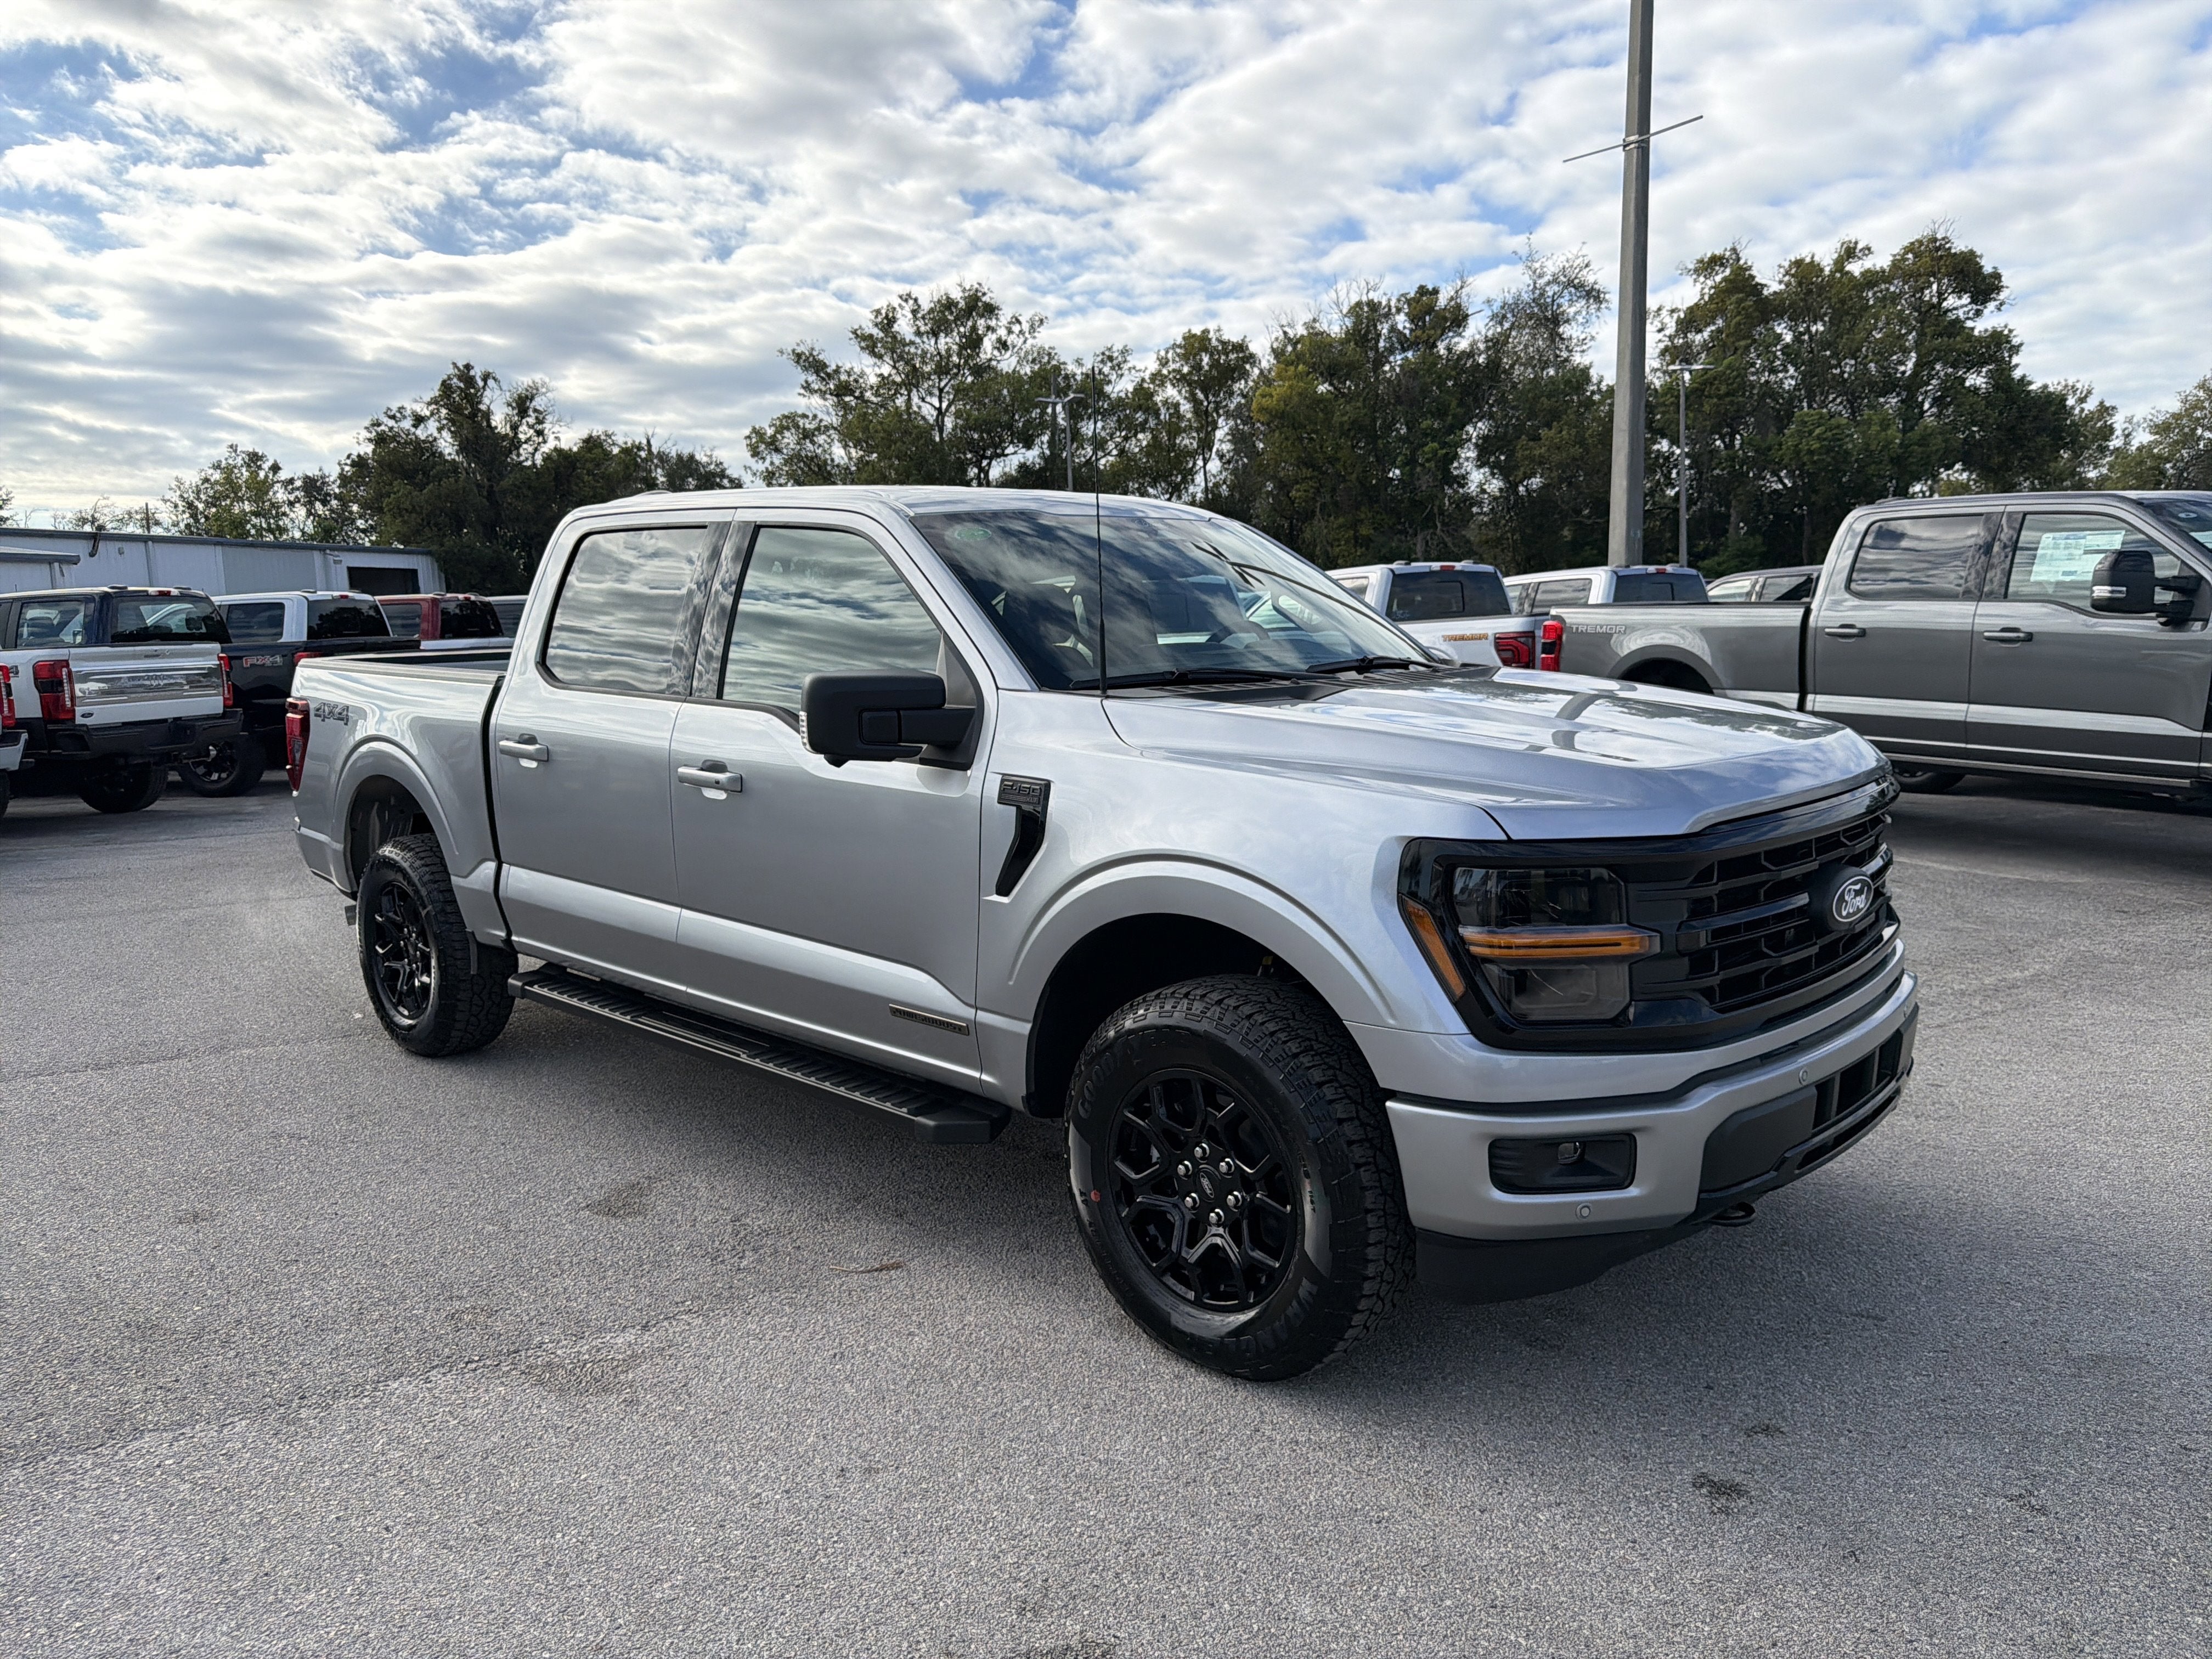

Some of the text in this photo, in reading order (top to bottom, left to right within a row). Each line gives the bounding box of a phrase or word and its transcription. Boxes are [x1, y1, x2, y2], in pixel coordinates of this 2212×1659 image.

[1571, 624, 1626, 634] TREMOR
[1442, 633, 1488, 642] TREMOR
[243, 654, 282, 668] FX4
[1842, 883, 1867, 917] Ford
